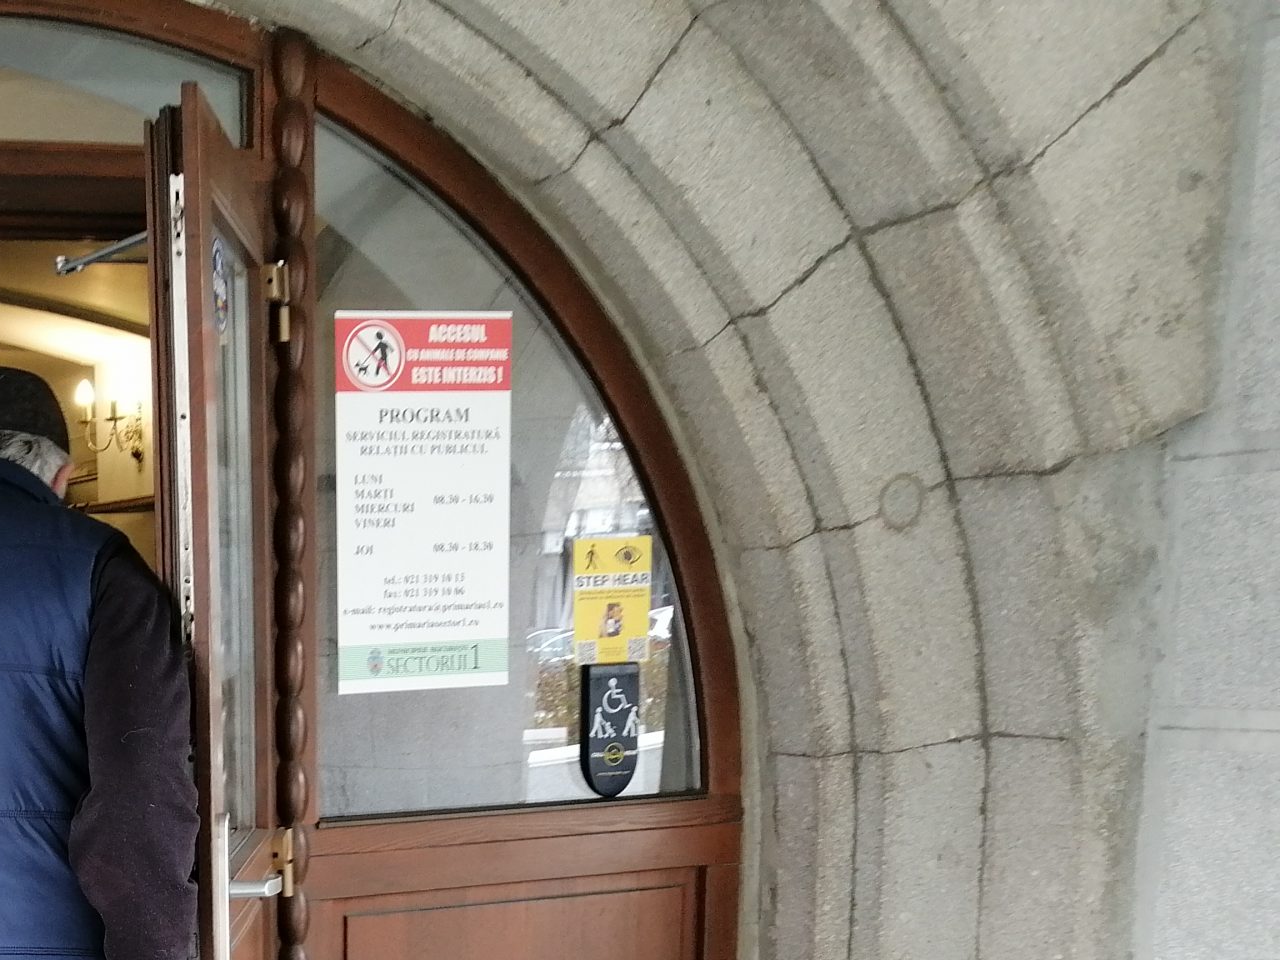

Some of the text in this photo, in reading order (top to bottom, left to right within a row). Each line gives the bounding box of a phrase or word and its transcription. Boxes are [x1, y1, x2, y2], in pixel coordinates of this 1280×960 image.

[428, 324, 487, 343] ACCESUL
[411, 366, 441, 384] ESTE
[378, 407, 471, 424] PROGRAM
[430, 443, 488, 455] PUBLICUL
[354, 474, 383, 485] LUNI
[354, 502, 415, 514] MIERCURI
[354, 517, 396, 528] VINERI
[576, 572, 650, 588] STEP HEAR
[386, 653, 469, 676] SECTORUL
[470, 643, 480, 671] 1
